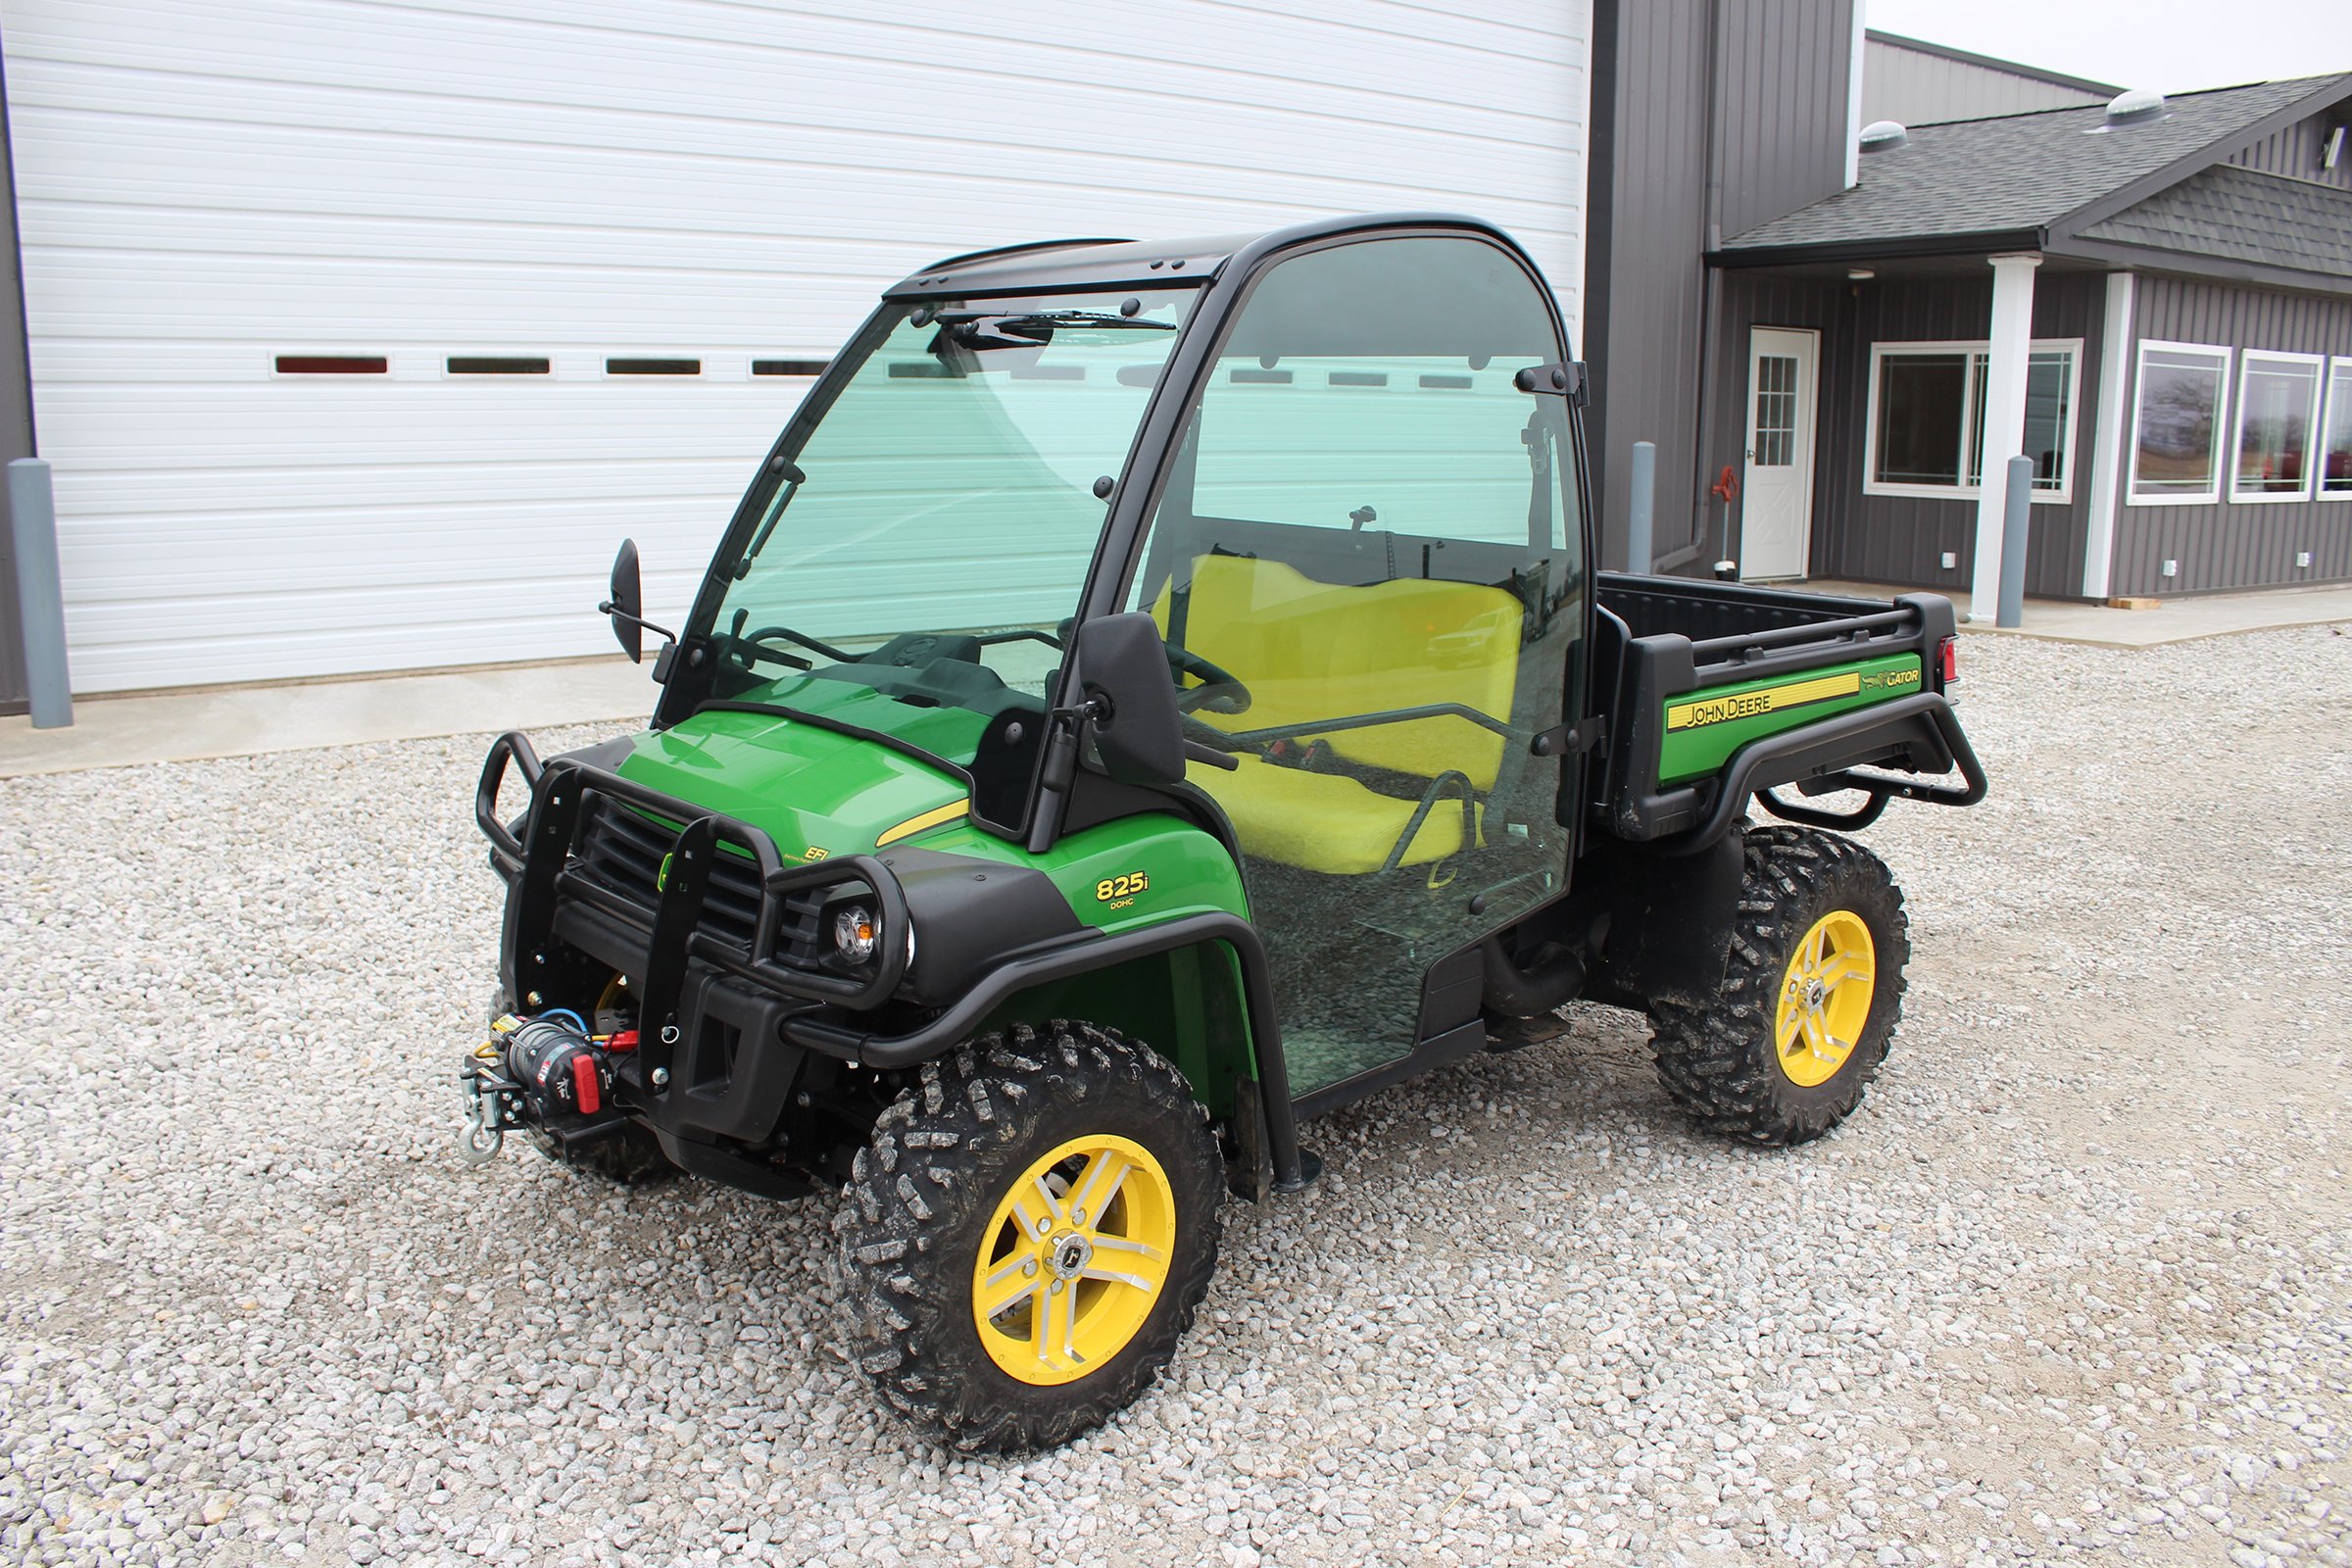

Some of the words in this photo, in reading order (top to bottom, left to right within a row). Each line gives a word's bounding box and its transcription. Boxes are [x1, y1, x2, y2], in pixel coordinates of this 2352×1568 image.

[1886, 669, 1919, 687] GATOR
[1687, 704, 1725, 725] JOHN
[1728, 695, 1770, 716] DEERE
[804, 846, 830, 861] EFI
[1097, 870, 1149, 901] 825i
[1110, 898, 1134, 910] DOHC
